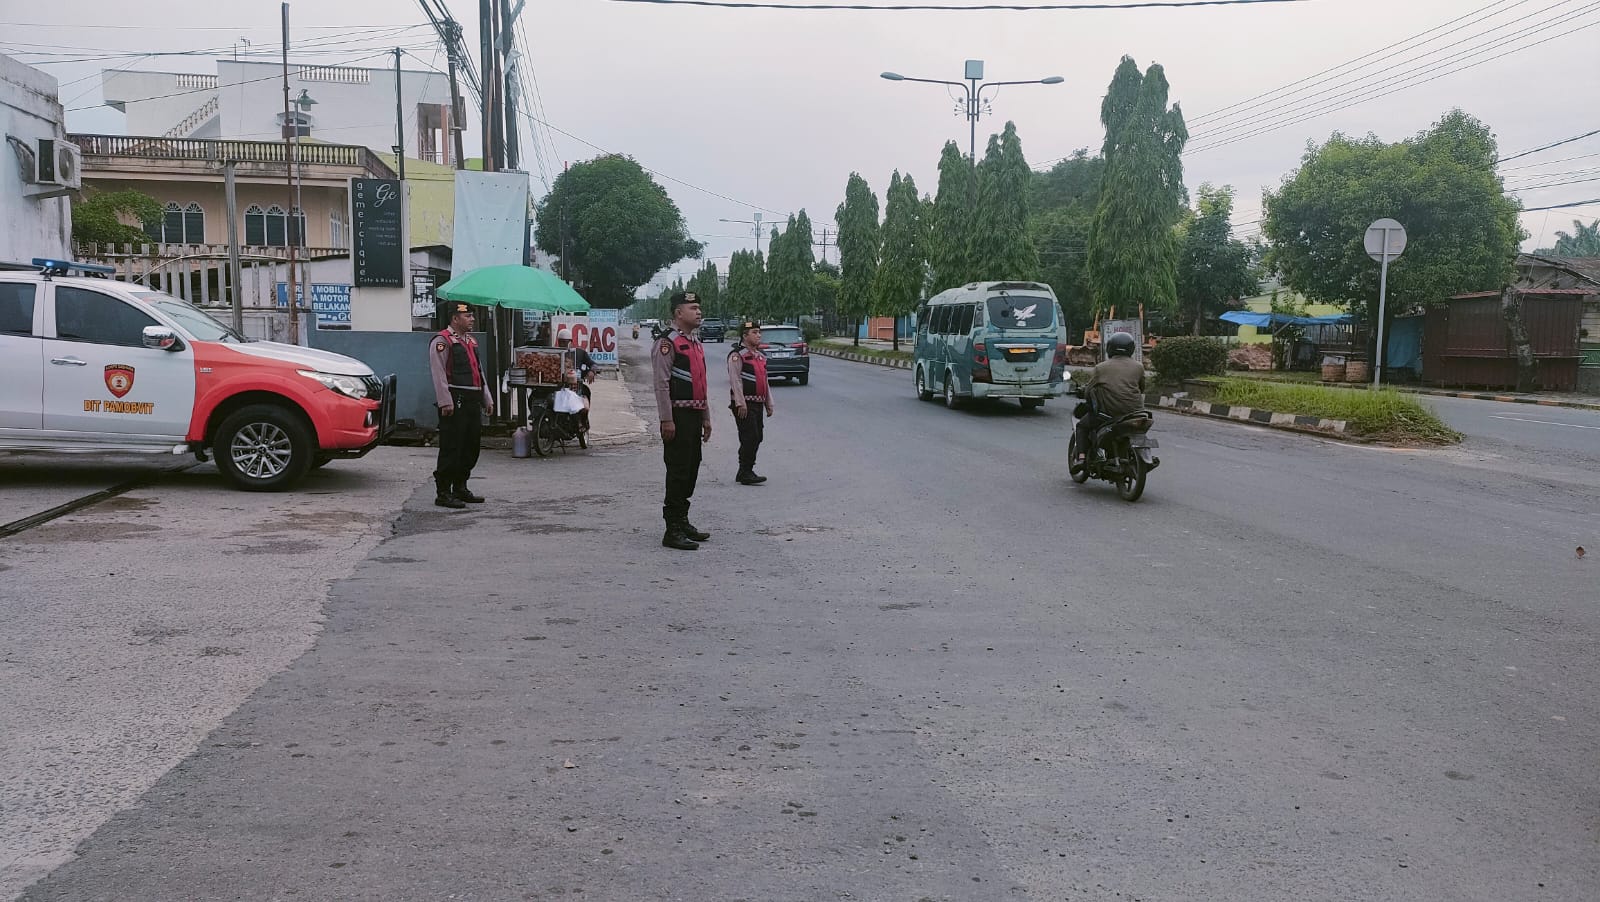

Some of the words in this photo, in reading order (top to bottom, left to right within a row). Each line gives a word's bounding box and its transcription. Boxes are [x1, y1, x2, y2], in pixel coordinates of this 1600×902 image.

[316, 285, 343, 294] MOBIL
[320, 294, 349, 302] MOTOR
[313, 302, 351, 311] BELAKAN
[589, 326, 616, 353] AC
[83, 400, 101, 412] DIT
